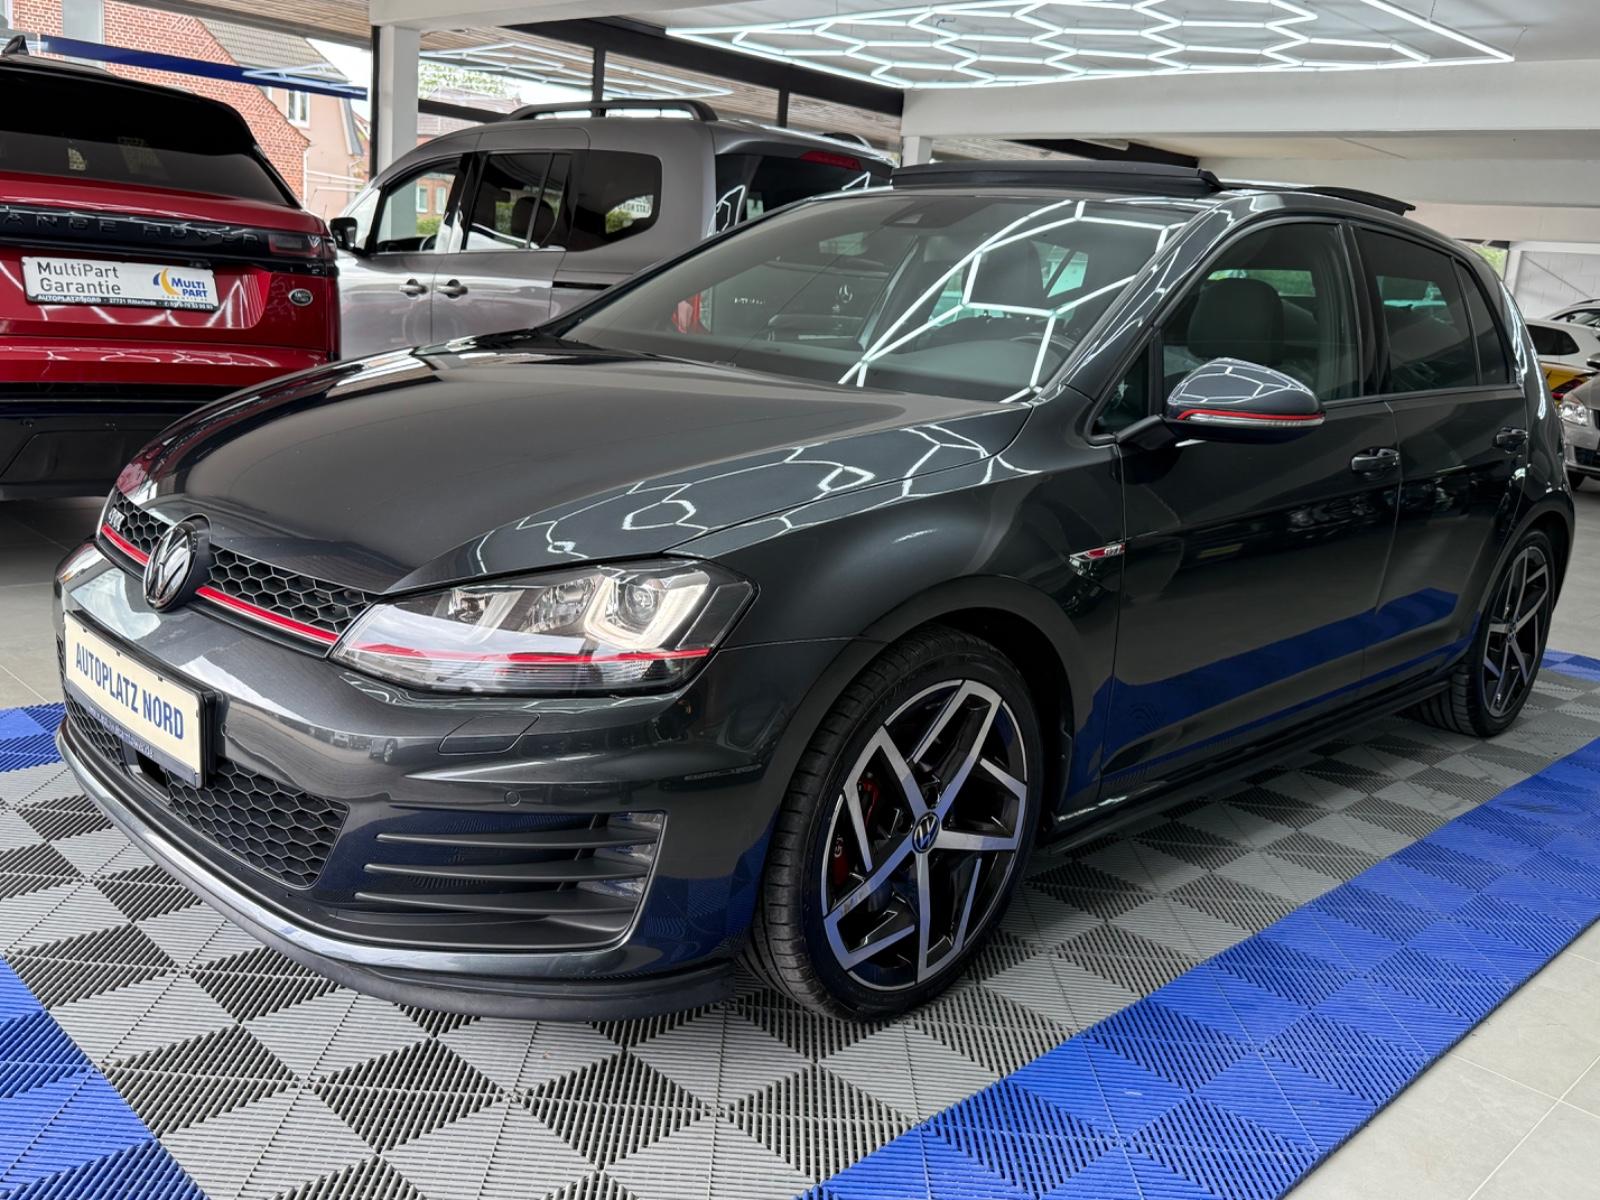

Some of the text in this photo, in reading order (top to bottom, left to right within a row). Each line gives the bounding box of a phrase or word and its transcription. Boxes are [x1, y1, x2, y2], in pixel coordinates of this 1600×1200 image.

[37, 262, 119, 279] MultiPart
[40, 278, 121, 295] Garantie
[171, 277, 206, 289] MULTI
[182, 288, 208, 298] PART
[76, 642, 139, 715] AUTOPLATZ
[142, 688, 184, 741] NORD
